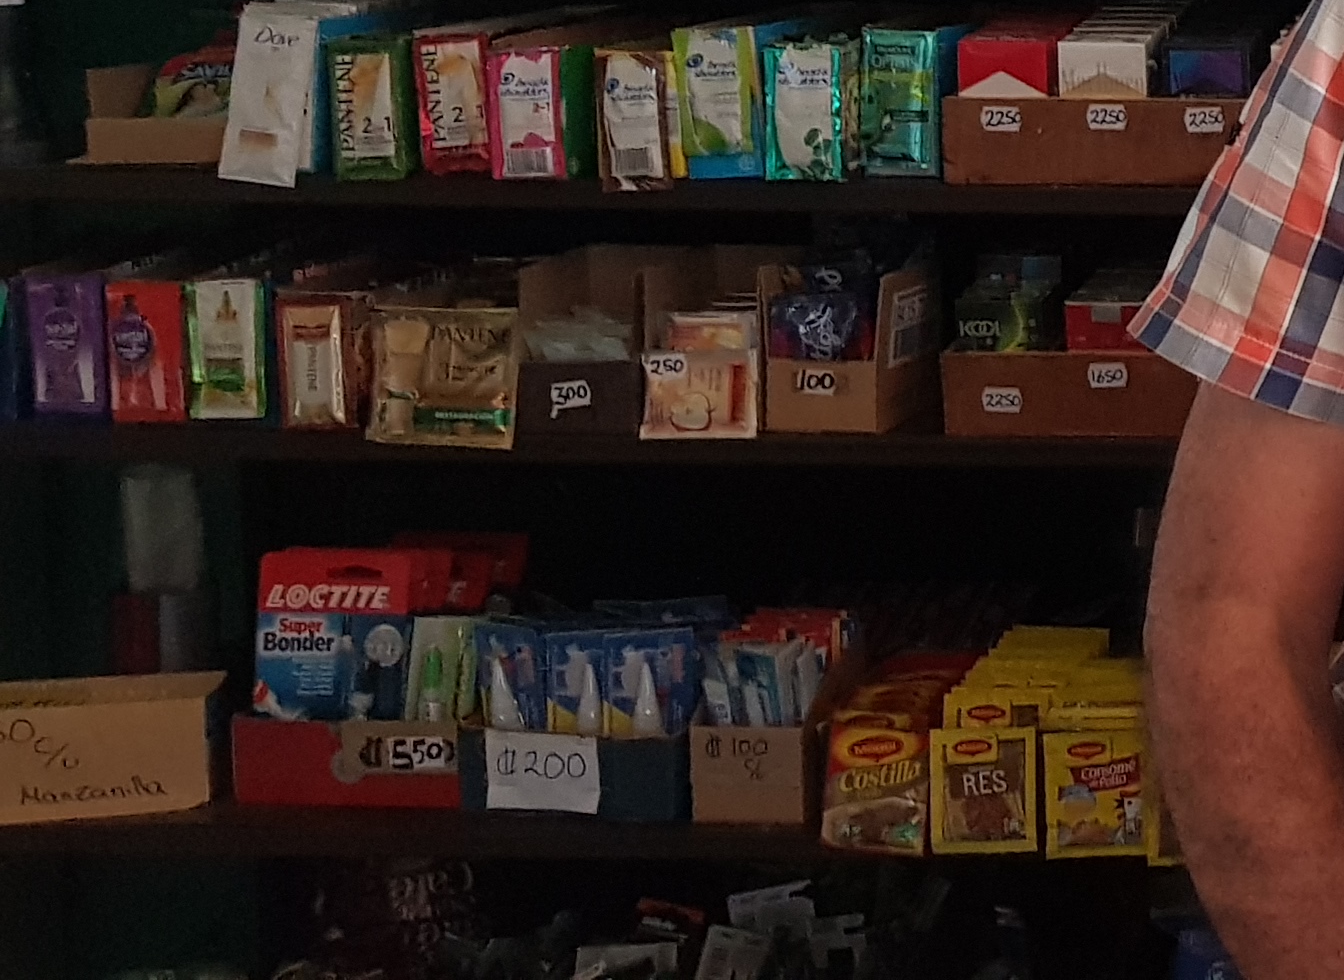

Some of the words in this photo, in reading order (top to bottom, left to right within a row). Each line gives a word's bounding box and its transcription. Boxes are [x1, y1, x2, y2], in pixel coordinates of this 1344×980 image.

[985, 109, 1021, 127] 2250
[1089, 107, 1126, 125] 2250
[1188, 110, 1224, 127] 2250
[651, 358, 685, 374] 250
[798, 371, 835, 390] 100
[552, 384, 588, 405] 300
[984, 392, 1021, 407] 2250
[264, 583, 391, 610] LOCTITE
[278, 619, 323, 633] Super
[263, 632, 335, 652] Bonder
[838, 760, 922, 793] Costilla
[962, 770, 1009, 796] RES
